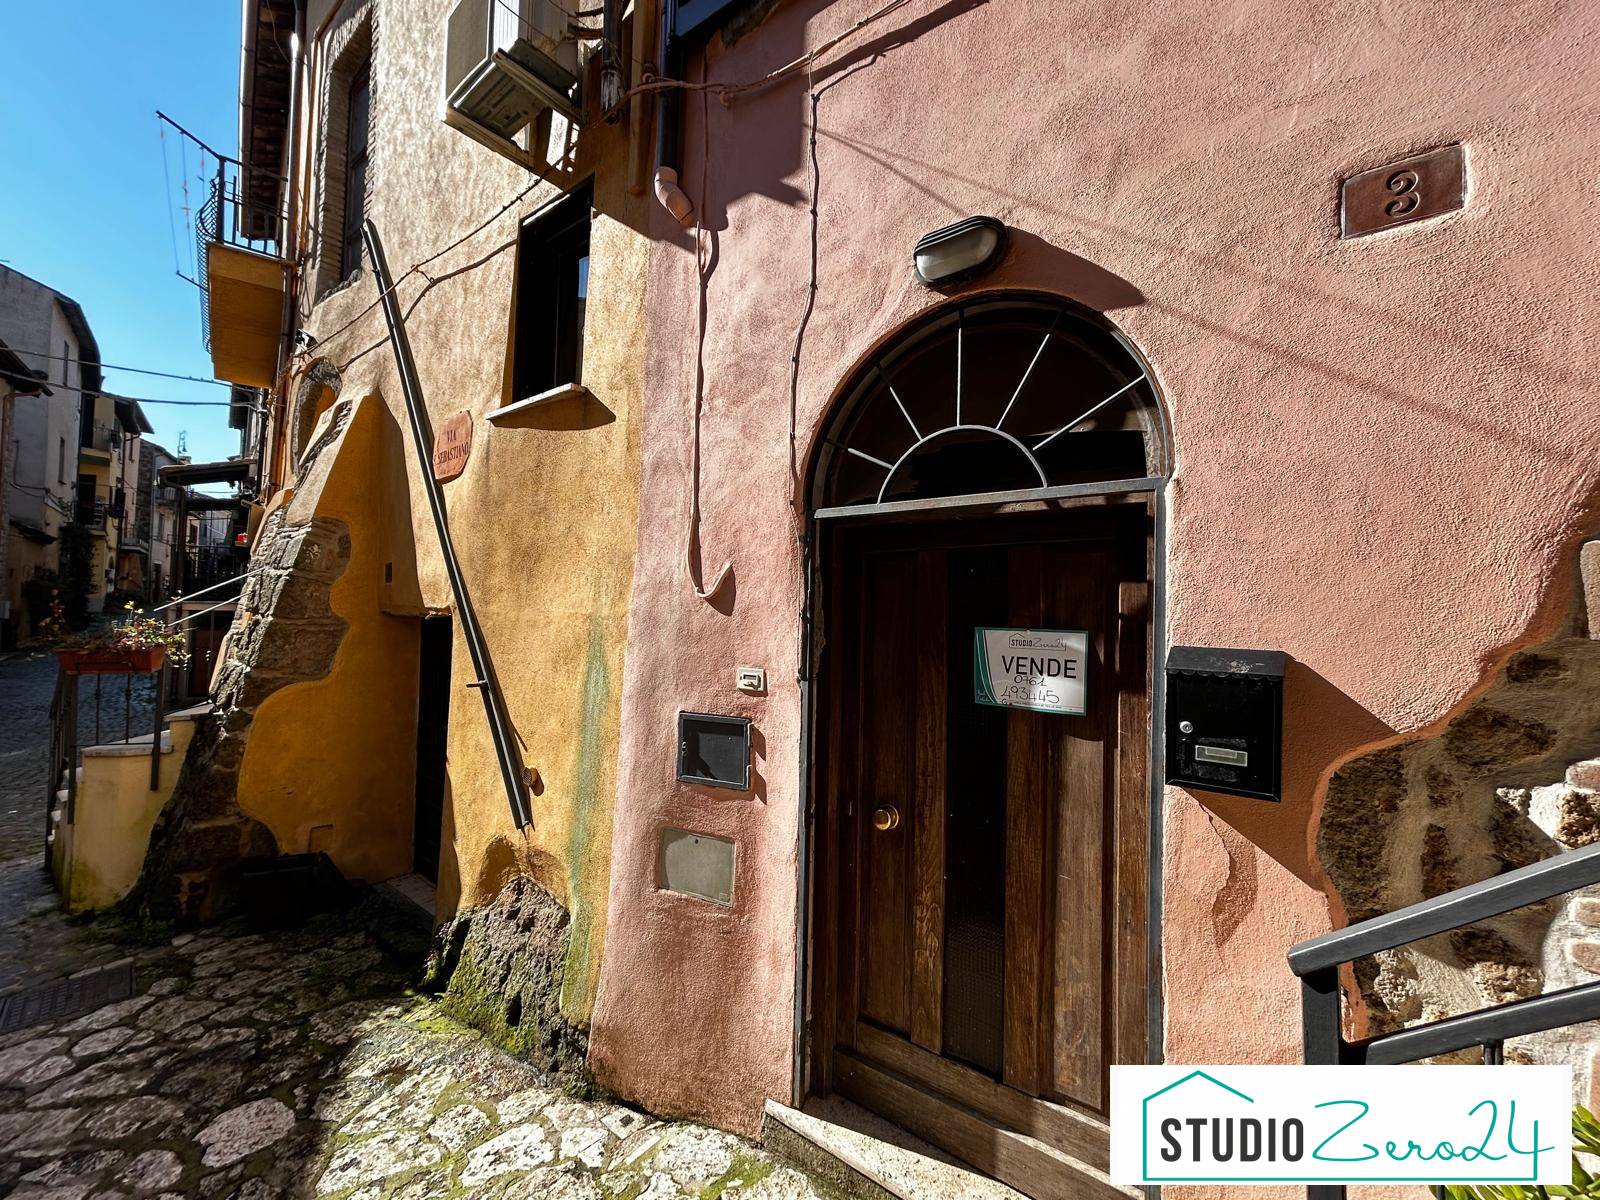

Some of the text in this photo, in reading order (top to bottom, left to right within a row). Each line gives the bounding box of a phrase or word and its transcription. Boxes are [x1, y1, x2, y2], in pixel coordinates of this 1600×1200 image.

[1385, 170, 1420, 218] 3
[1011, 639, 1033, 647] STUDIO
[1001, 656, 1077, 678] VENDE
[1014, 674, 1047, 687] 0761
[1000, 686, 1059, 703] 493445
